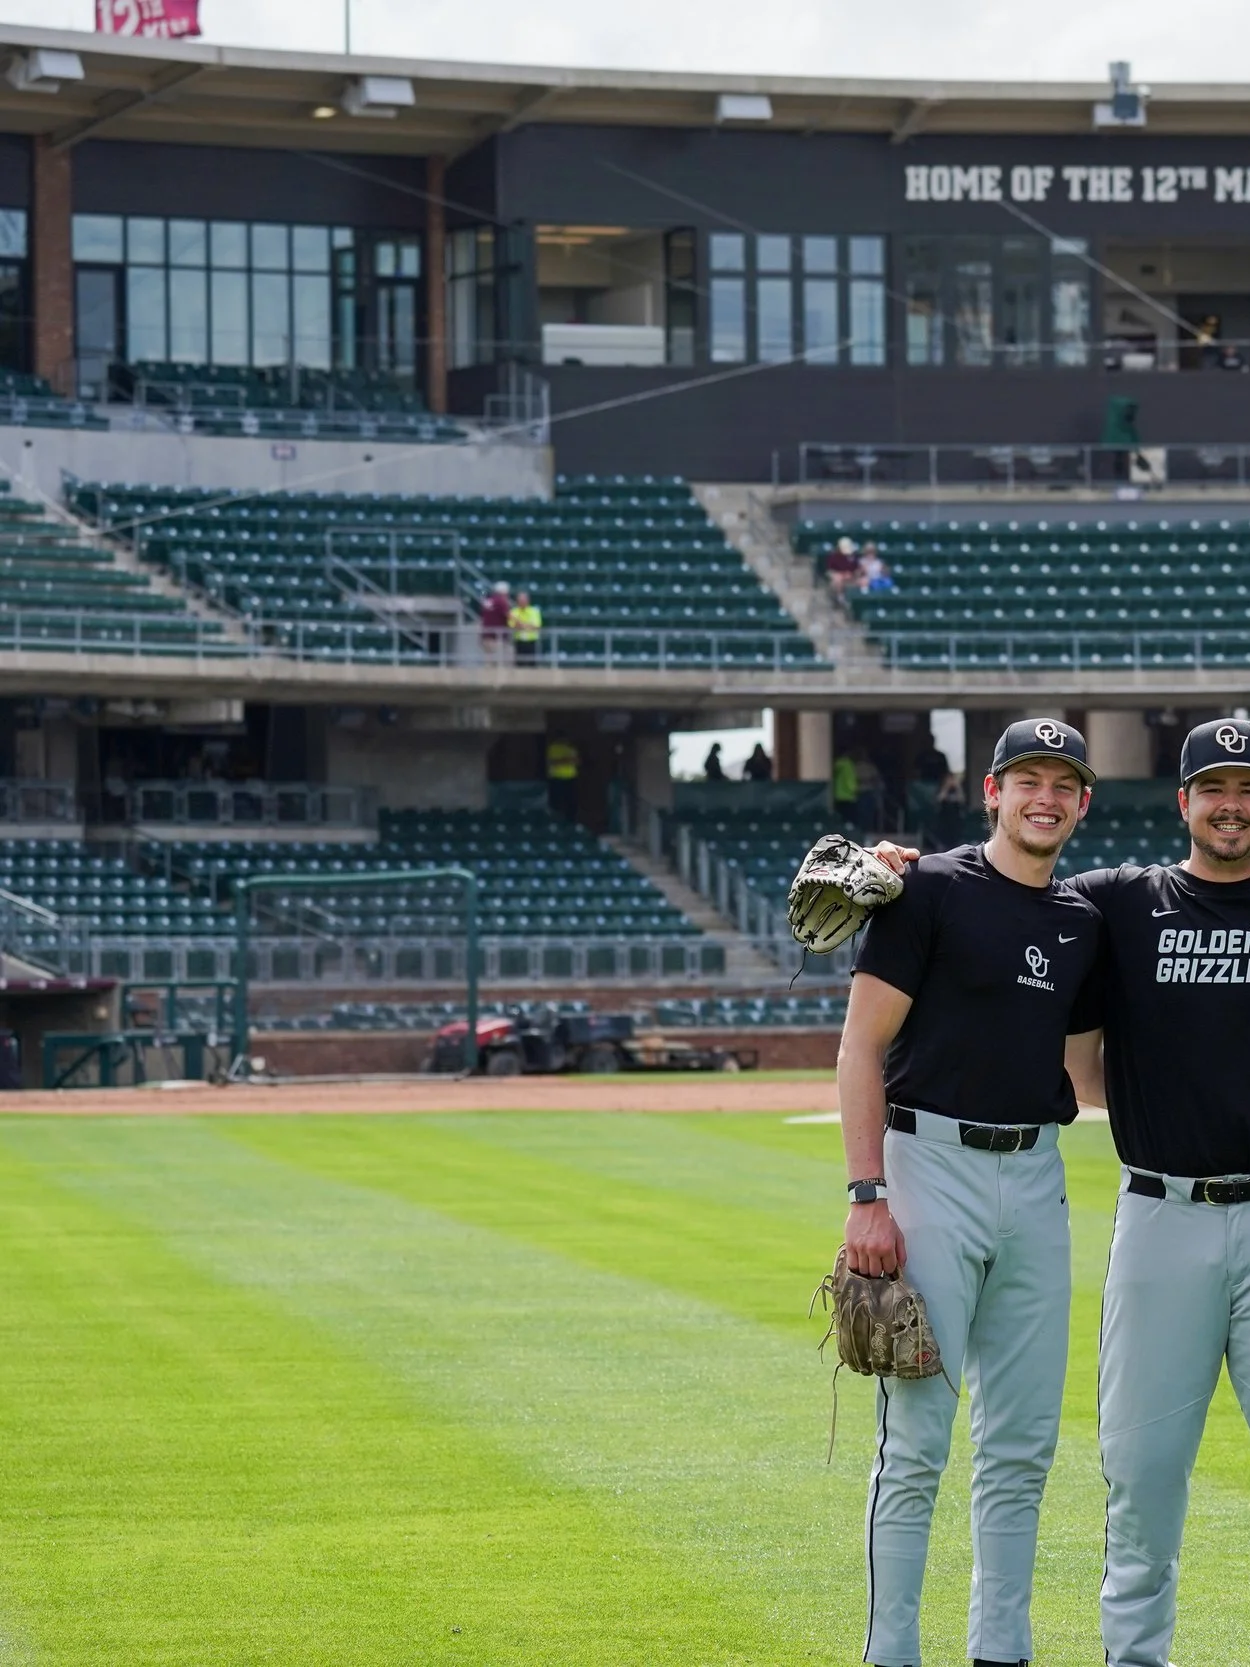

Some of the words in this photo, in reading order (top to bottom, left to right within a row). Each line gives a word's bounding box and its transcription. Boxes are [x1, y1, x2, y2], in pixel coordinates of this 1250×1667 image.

[904, 165, 1003, 201] HOME
[1010, 165, 1055, 201] OF
[1061, 166, 1133, 201] THE
[1035, 722, 1067, 749] OU
[1215, 725, 1249, 754] OU
[1025, 945, 1050, 978] OU
[1016, 975, 1055, 991] BASEBALL
